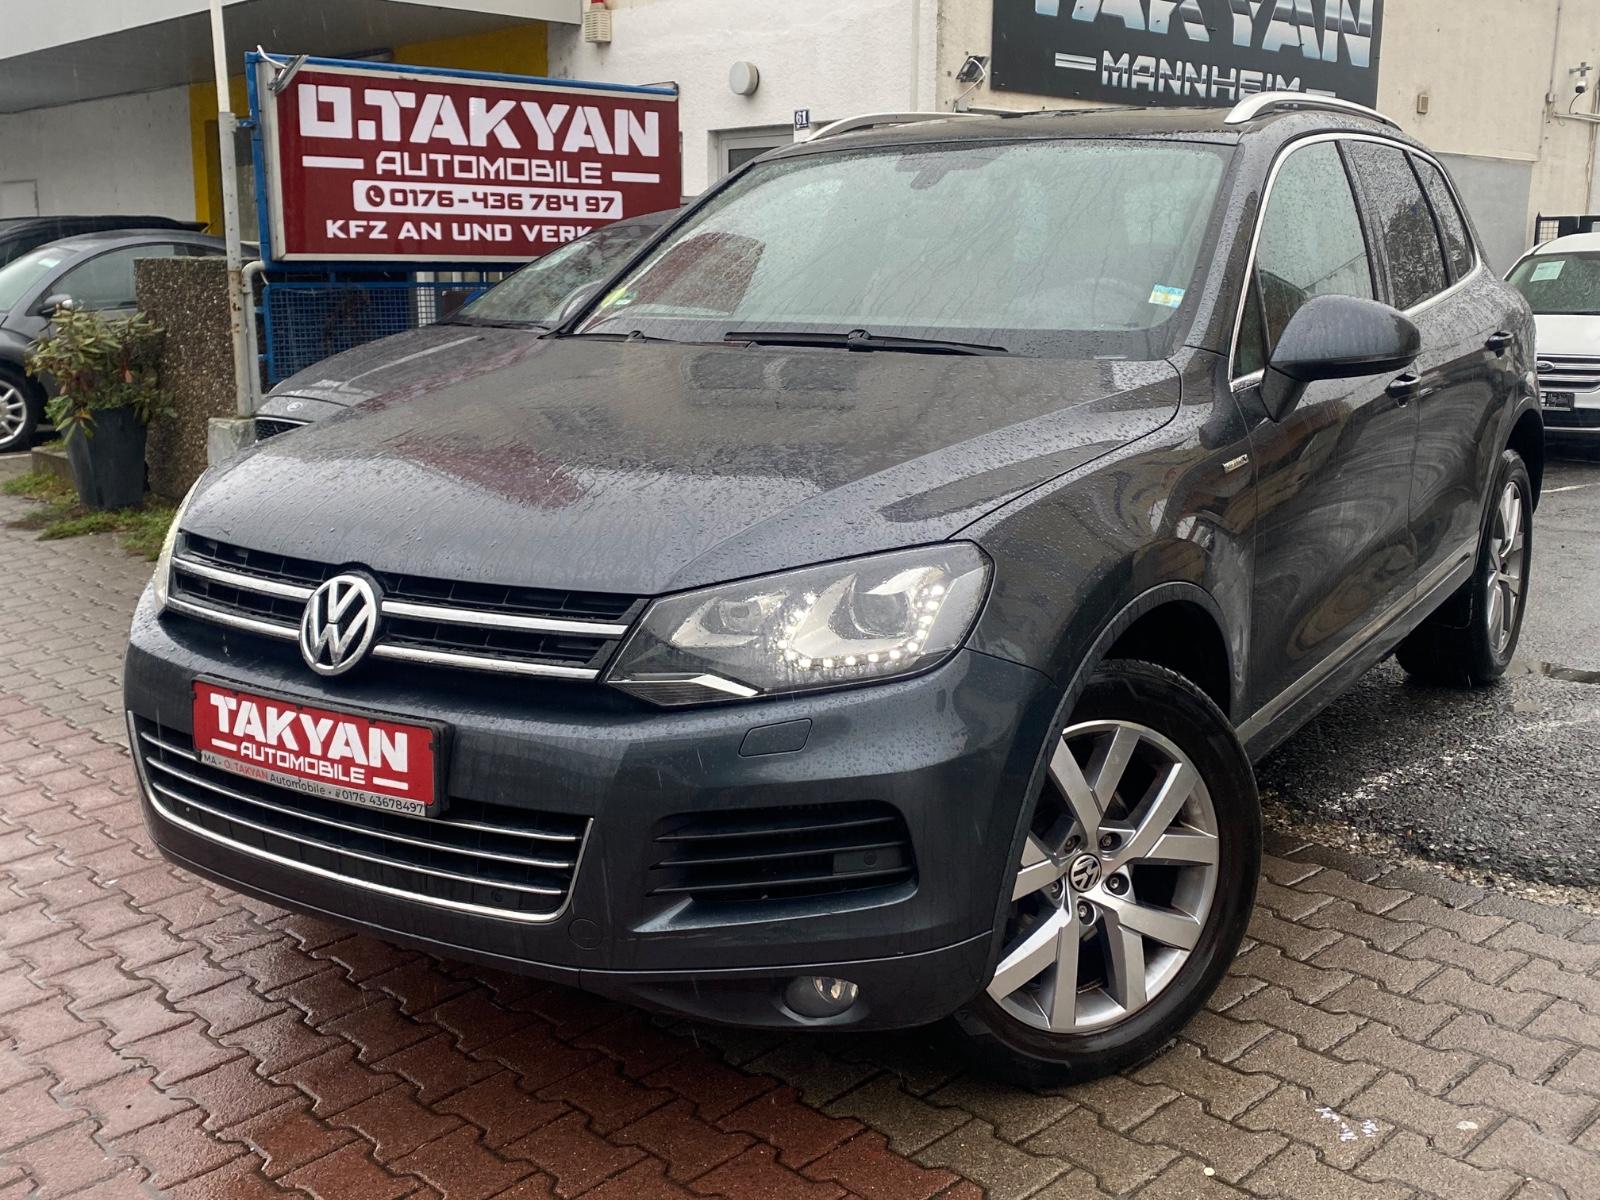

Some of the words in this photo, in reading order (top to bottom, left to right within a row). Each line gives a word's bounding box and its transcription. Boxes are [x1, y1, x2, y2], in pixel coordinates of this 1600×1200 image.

[1101, 50, 1301, 100] MANNHEIM
[795, 111, 808, 125] 61
[375, 151, 603, 184] AUTOMOBILE
[390, 188, 523, 210] 0176-436
[529, 193, 579, 212] 784
[586, 196, 616, 213] 97
[326, 219, 388, 240] KFZ
[398, 221, 442, 241] AN
[452, 223, 513, 242] UND
[209, 692, 409, 773] TAKYAN
[240, 741, 366, 784] AUTOMOBILE
[270, 773, 326, 795] Automobile
[341, 789, 366, 804] 0176
[369, 795, 425, 814] 43678497
